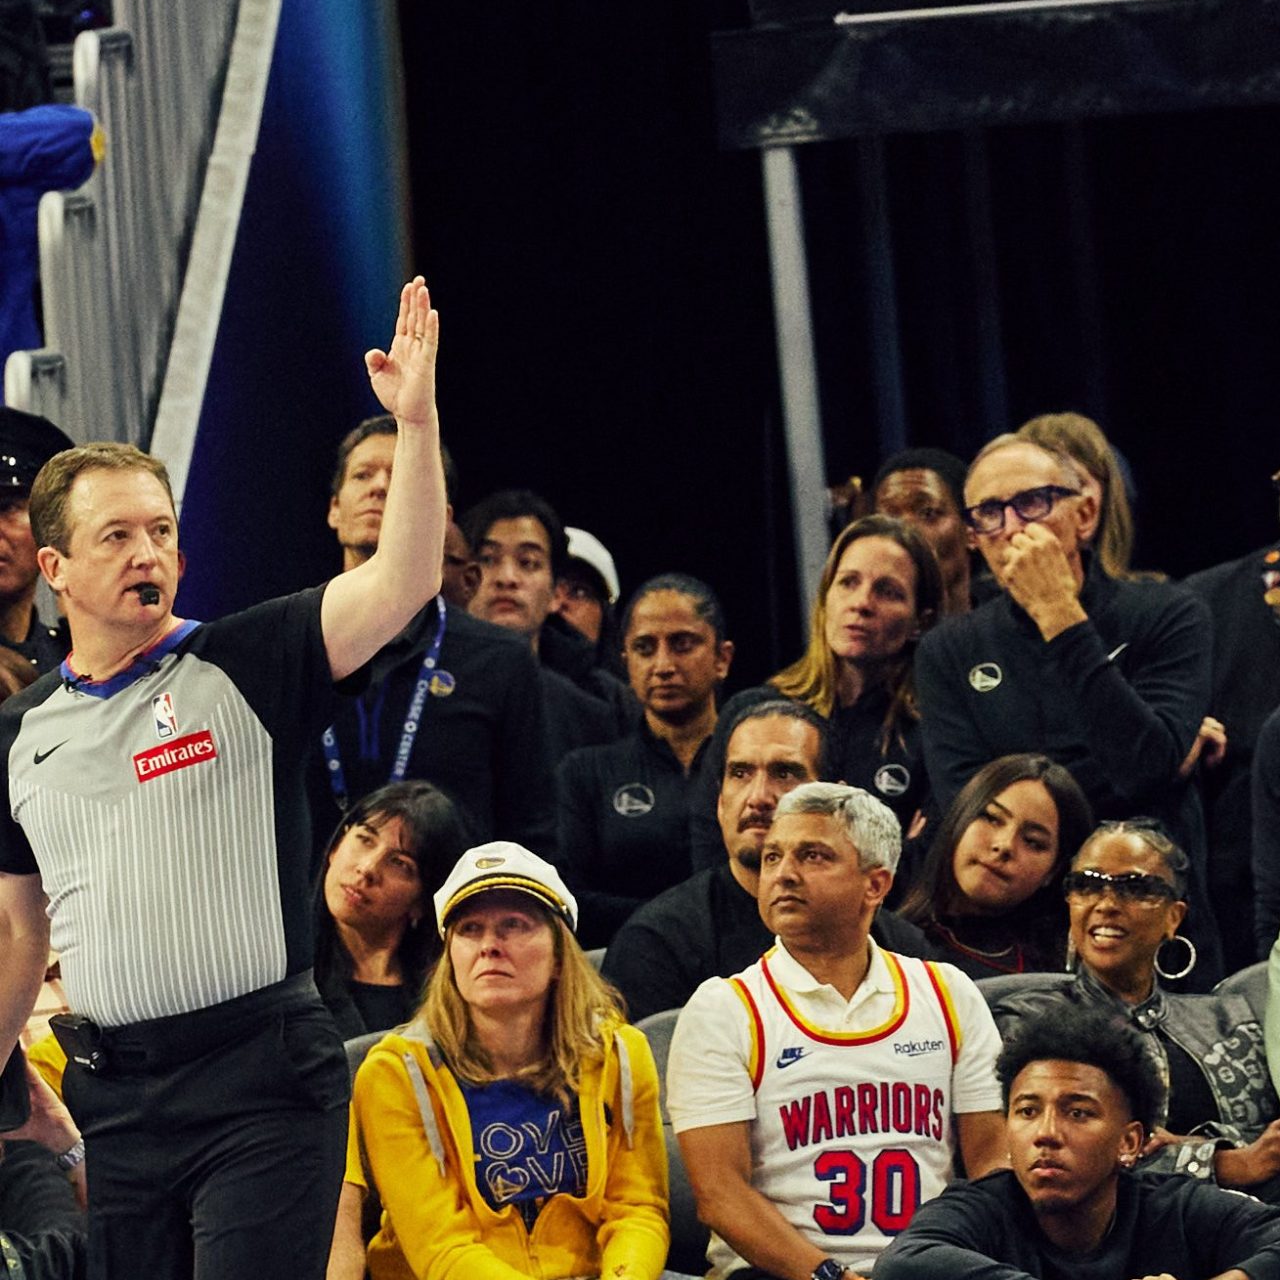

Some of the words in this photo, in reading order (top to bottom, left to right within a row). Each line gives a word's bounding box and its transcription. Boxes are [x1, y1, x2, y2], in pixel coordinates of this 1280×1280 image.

[136, 739, 214, 776] Emirates
[893, 1039, 945, 1055] Rakuten
[779, 1081, 945, 1152] WARRIORS
[813, 1148, 922, 1238] 30
